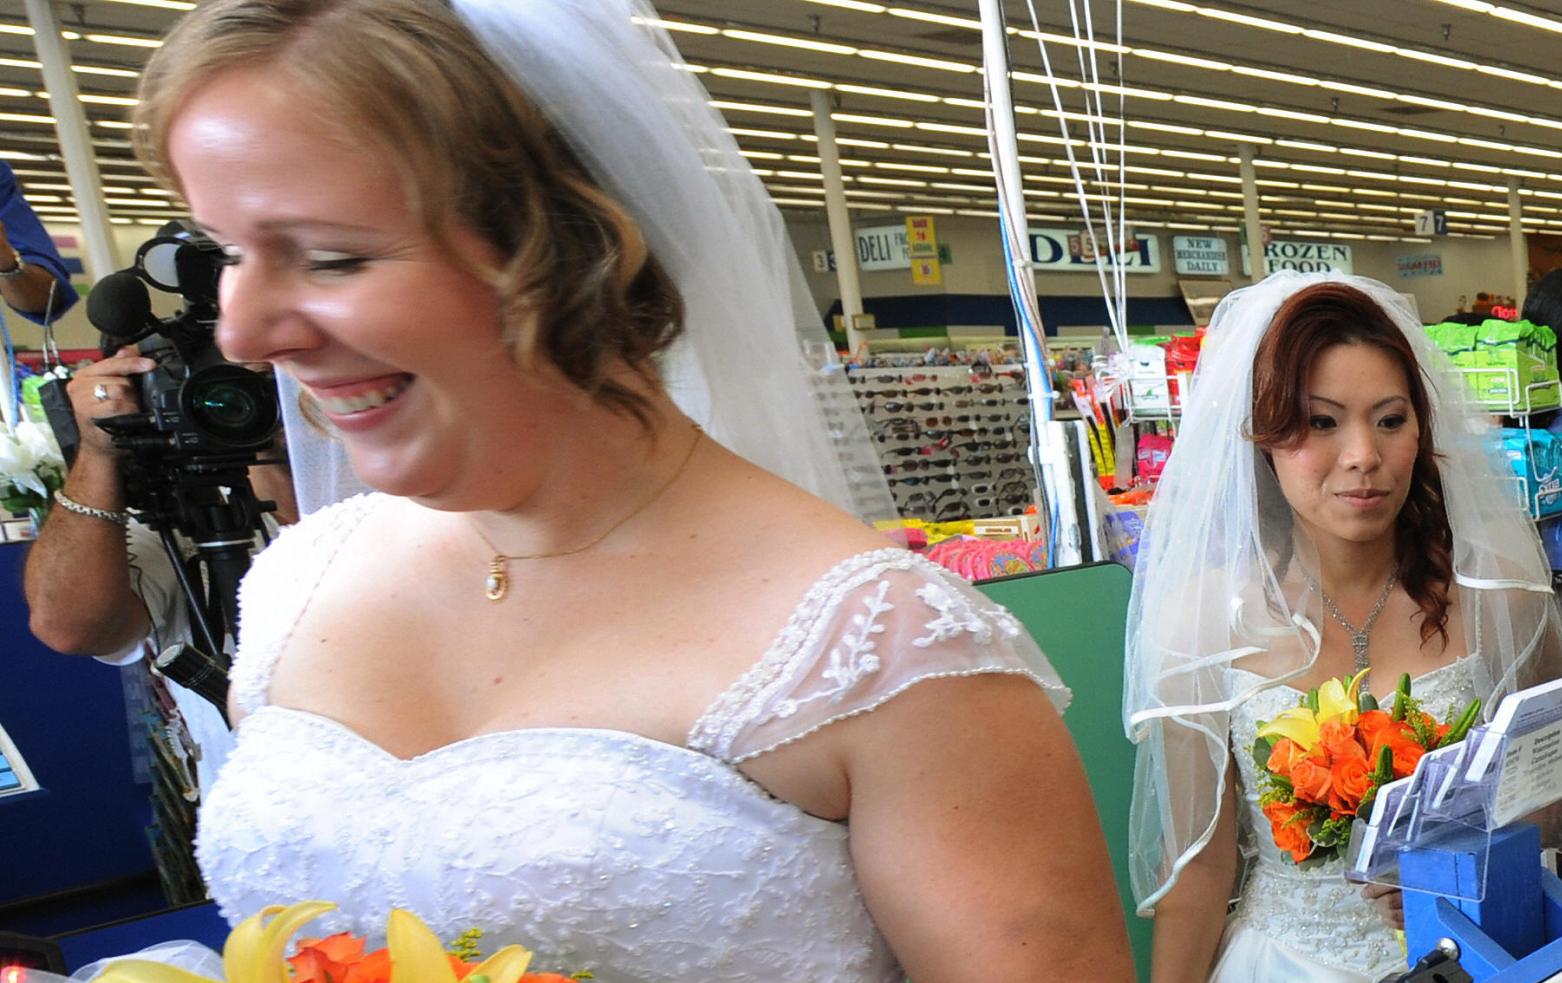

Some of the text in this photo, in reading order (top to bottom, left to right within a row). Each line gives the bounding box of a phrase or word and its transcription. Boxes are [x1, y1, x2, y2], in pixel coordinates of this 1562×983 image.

[1420, 216, 1428, 231] 7
[858, 234, 892, 264] DELI
[1029, 233, 1153, 267] DI
[1070, 239, 1079, 251] 5
[1186, 238, 1212, 249] NEW
[1260, 244, 1348, 261] ROZEN
[1186, 261, 1219, 272] DAILY
